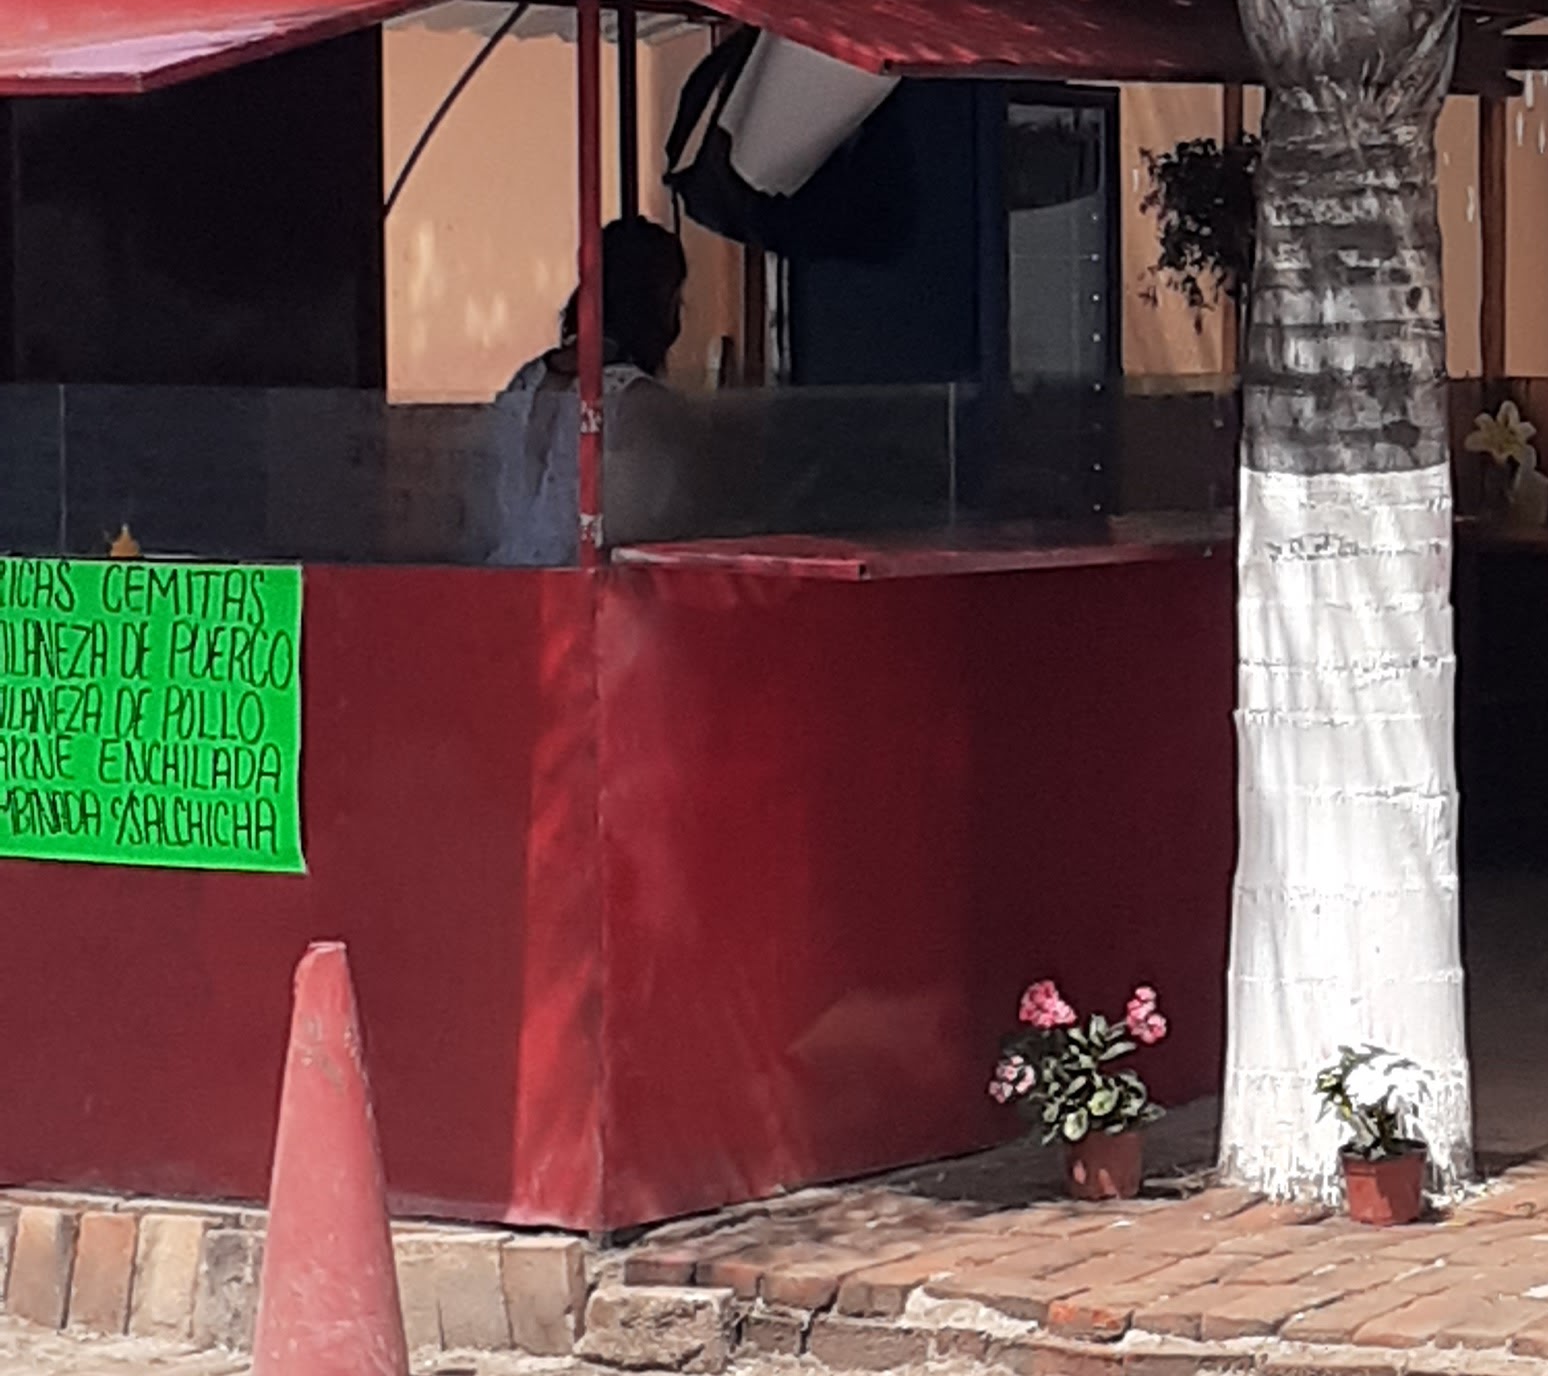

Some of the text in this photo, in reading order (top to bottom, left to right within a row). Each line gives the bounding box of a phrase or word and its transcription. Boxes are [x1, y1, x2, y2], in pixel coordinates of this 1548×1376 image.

[102, 564, 265, 627] CEMITAS
[0, 618, 294, 691] ILANEZA DE PUERCO
[115, 687, 152, 741] DE
[162, 684, 265, 745] POLLO
[98, 738, 281, 794] ENCHILADA
